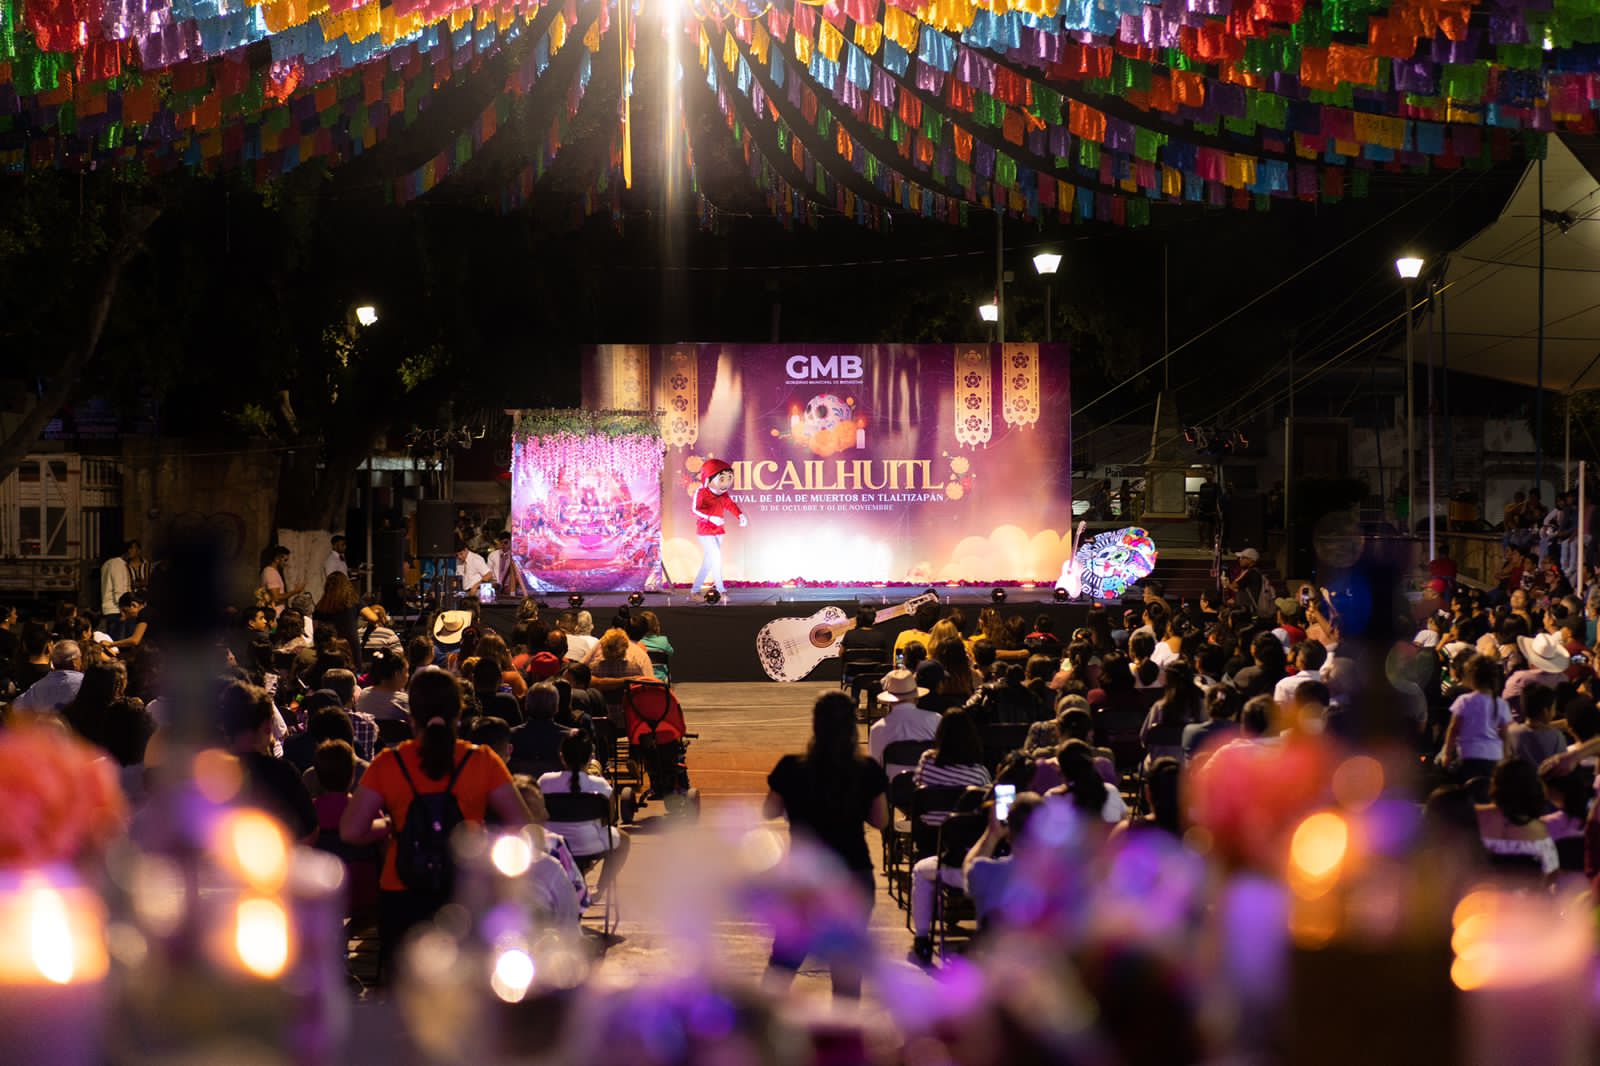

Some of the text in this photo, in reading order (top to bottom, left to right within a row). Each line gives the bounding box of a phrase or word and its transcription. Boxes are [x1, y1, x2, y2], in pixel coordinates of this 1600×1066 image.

[786, 355, 863, 379] GMB
[760, 494, 772, 502] DE
[775, 493, 792, 502] DÍA
[795, 494, 808, 502] DE
[810, 494, 859, 502] MUERTOS
[862, 494, 874, 502] EN
